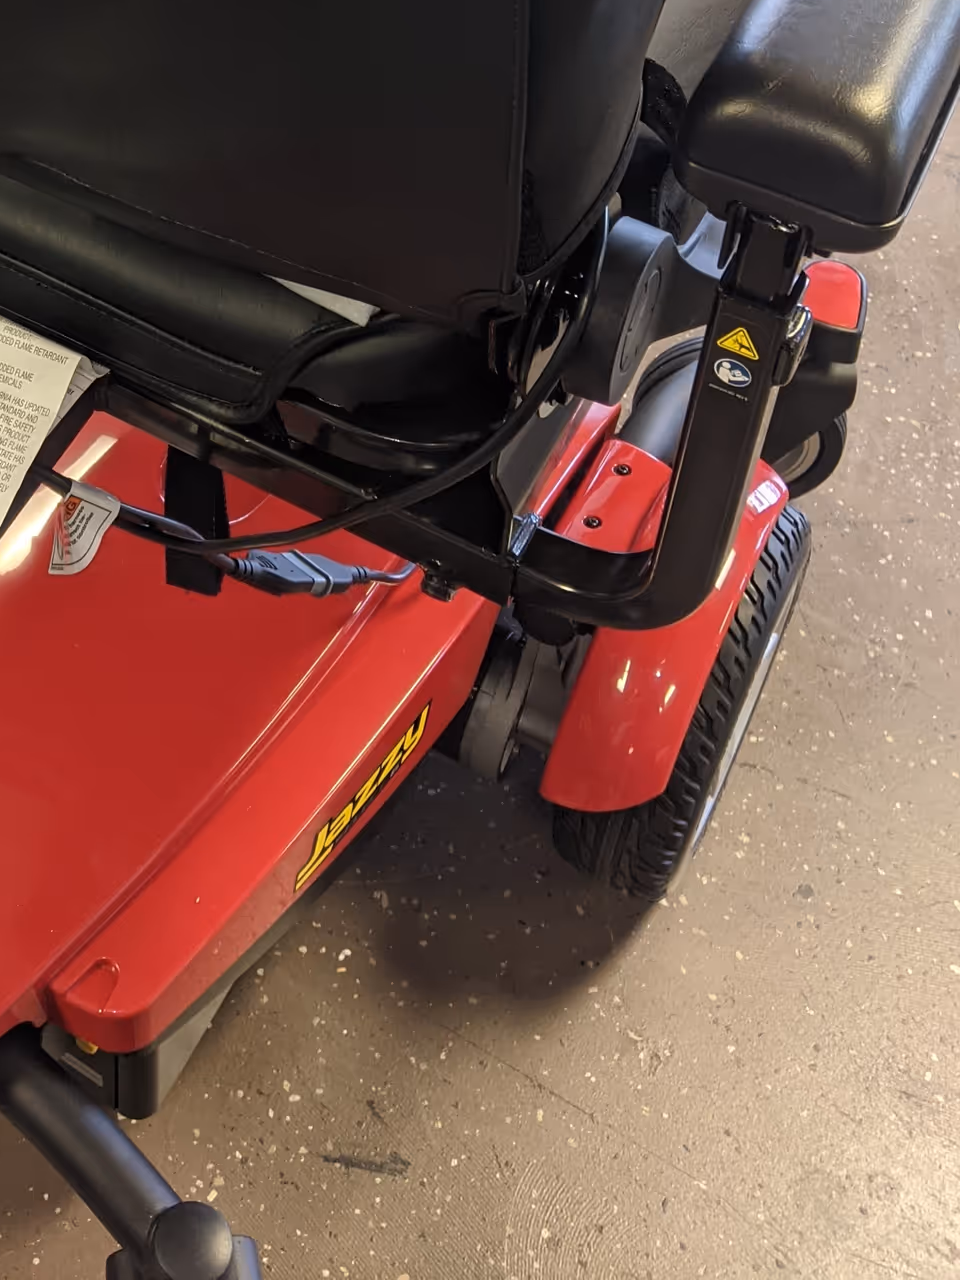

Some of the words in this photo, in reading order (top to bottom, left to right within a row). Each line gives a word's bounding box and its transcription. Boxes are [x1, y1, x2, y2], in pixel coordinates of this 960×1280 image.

[14, 339, 34, 352] FLAME
[33, 346, 68, 365] RETARDANT
[14, 368, 34, 381] FLAME
[11, 396, 24, 407] HAS
[24, 401, 50, 416] UPDATED
[24, 412, 38, 423] AND
[12, 419, 36, 434] SAFETY
[1, 427, 30, 443] PRODUCT
[7, 441, 27, 453] FLAME
[12, 454, 25, 464] HAS
[1, 472, 11, 481] OR
[294, 702, 431, 892] Jazzy
